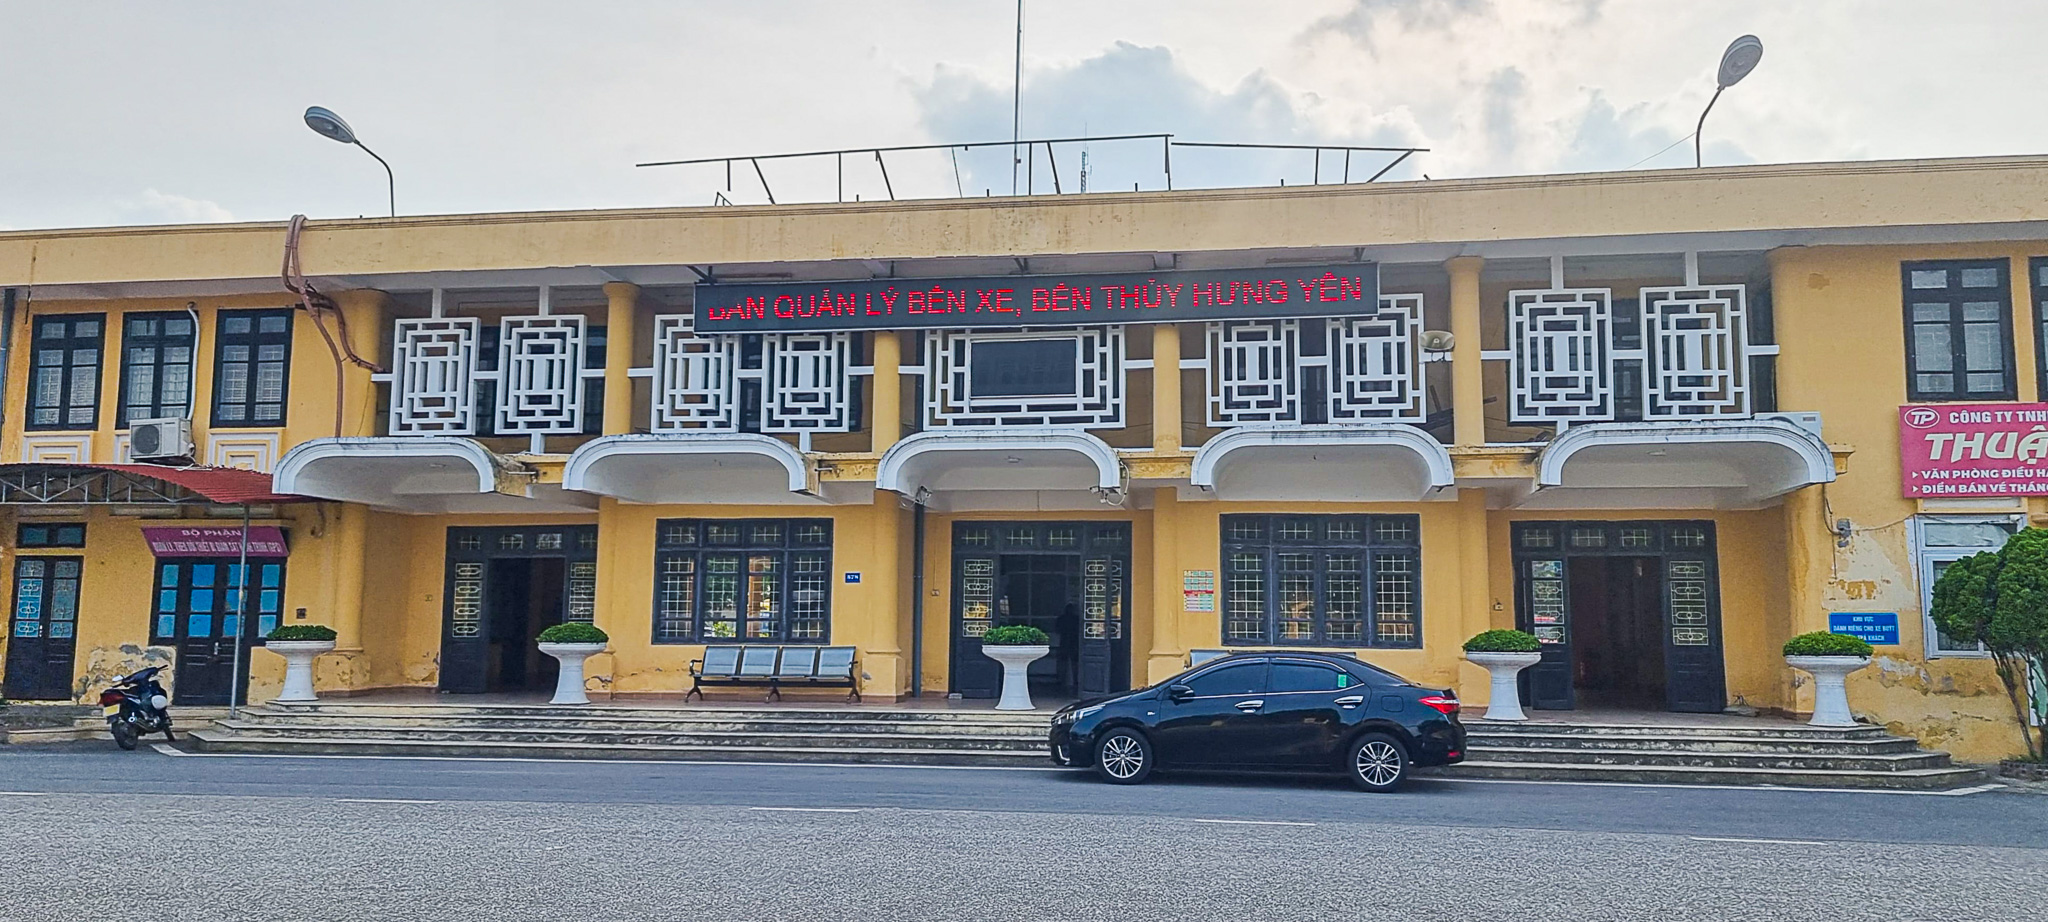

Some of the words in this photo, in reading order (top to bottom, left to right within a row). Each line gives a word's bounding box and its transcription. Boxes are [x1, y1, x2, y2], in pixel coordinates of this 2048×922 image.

[773, 288, 856, 319] QUẢN
[866, 286, 900, 316] LÝ
[975, 288, 1022, 318] XE,
[1100, 278, 1184, 310] THỦY
[1193, 279, 1288, 307] HƯNG
[1297, 271, 1361, 303] YÊN
[1911, 411, 1936, 425] TP
[1949, 410, 1992, 424] CÔNG
[1994, 411, 2013, 423] TY
[2016, 410, 2048, 423] TNH
[1921, 468, 1949, 479] VĂN
[1952, 468, 1999, 479] PHÒNG
[1958, 482, 1987, 493] BÁN
[1989, 481, 2007, 493] VÉ
[2009, 481, 2048, 493] THÁN
[182, 529, 200, 538] BỘ
